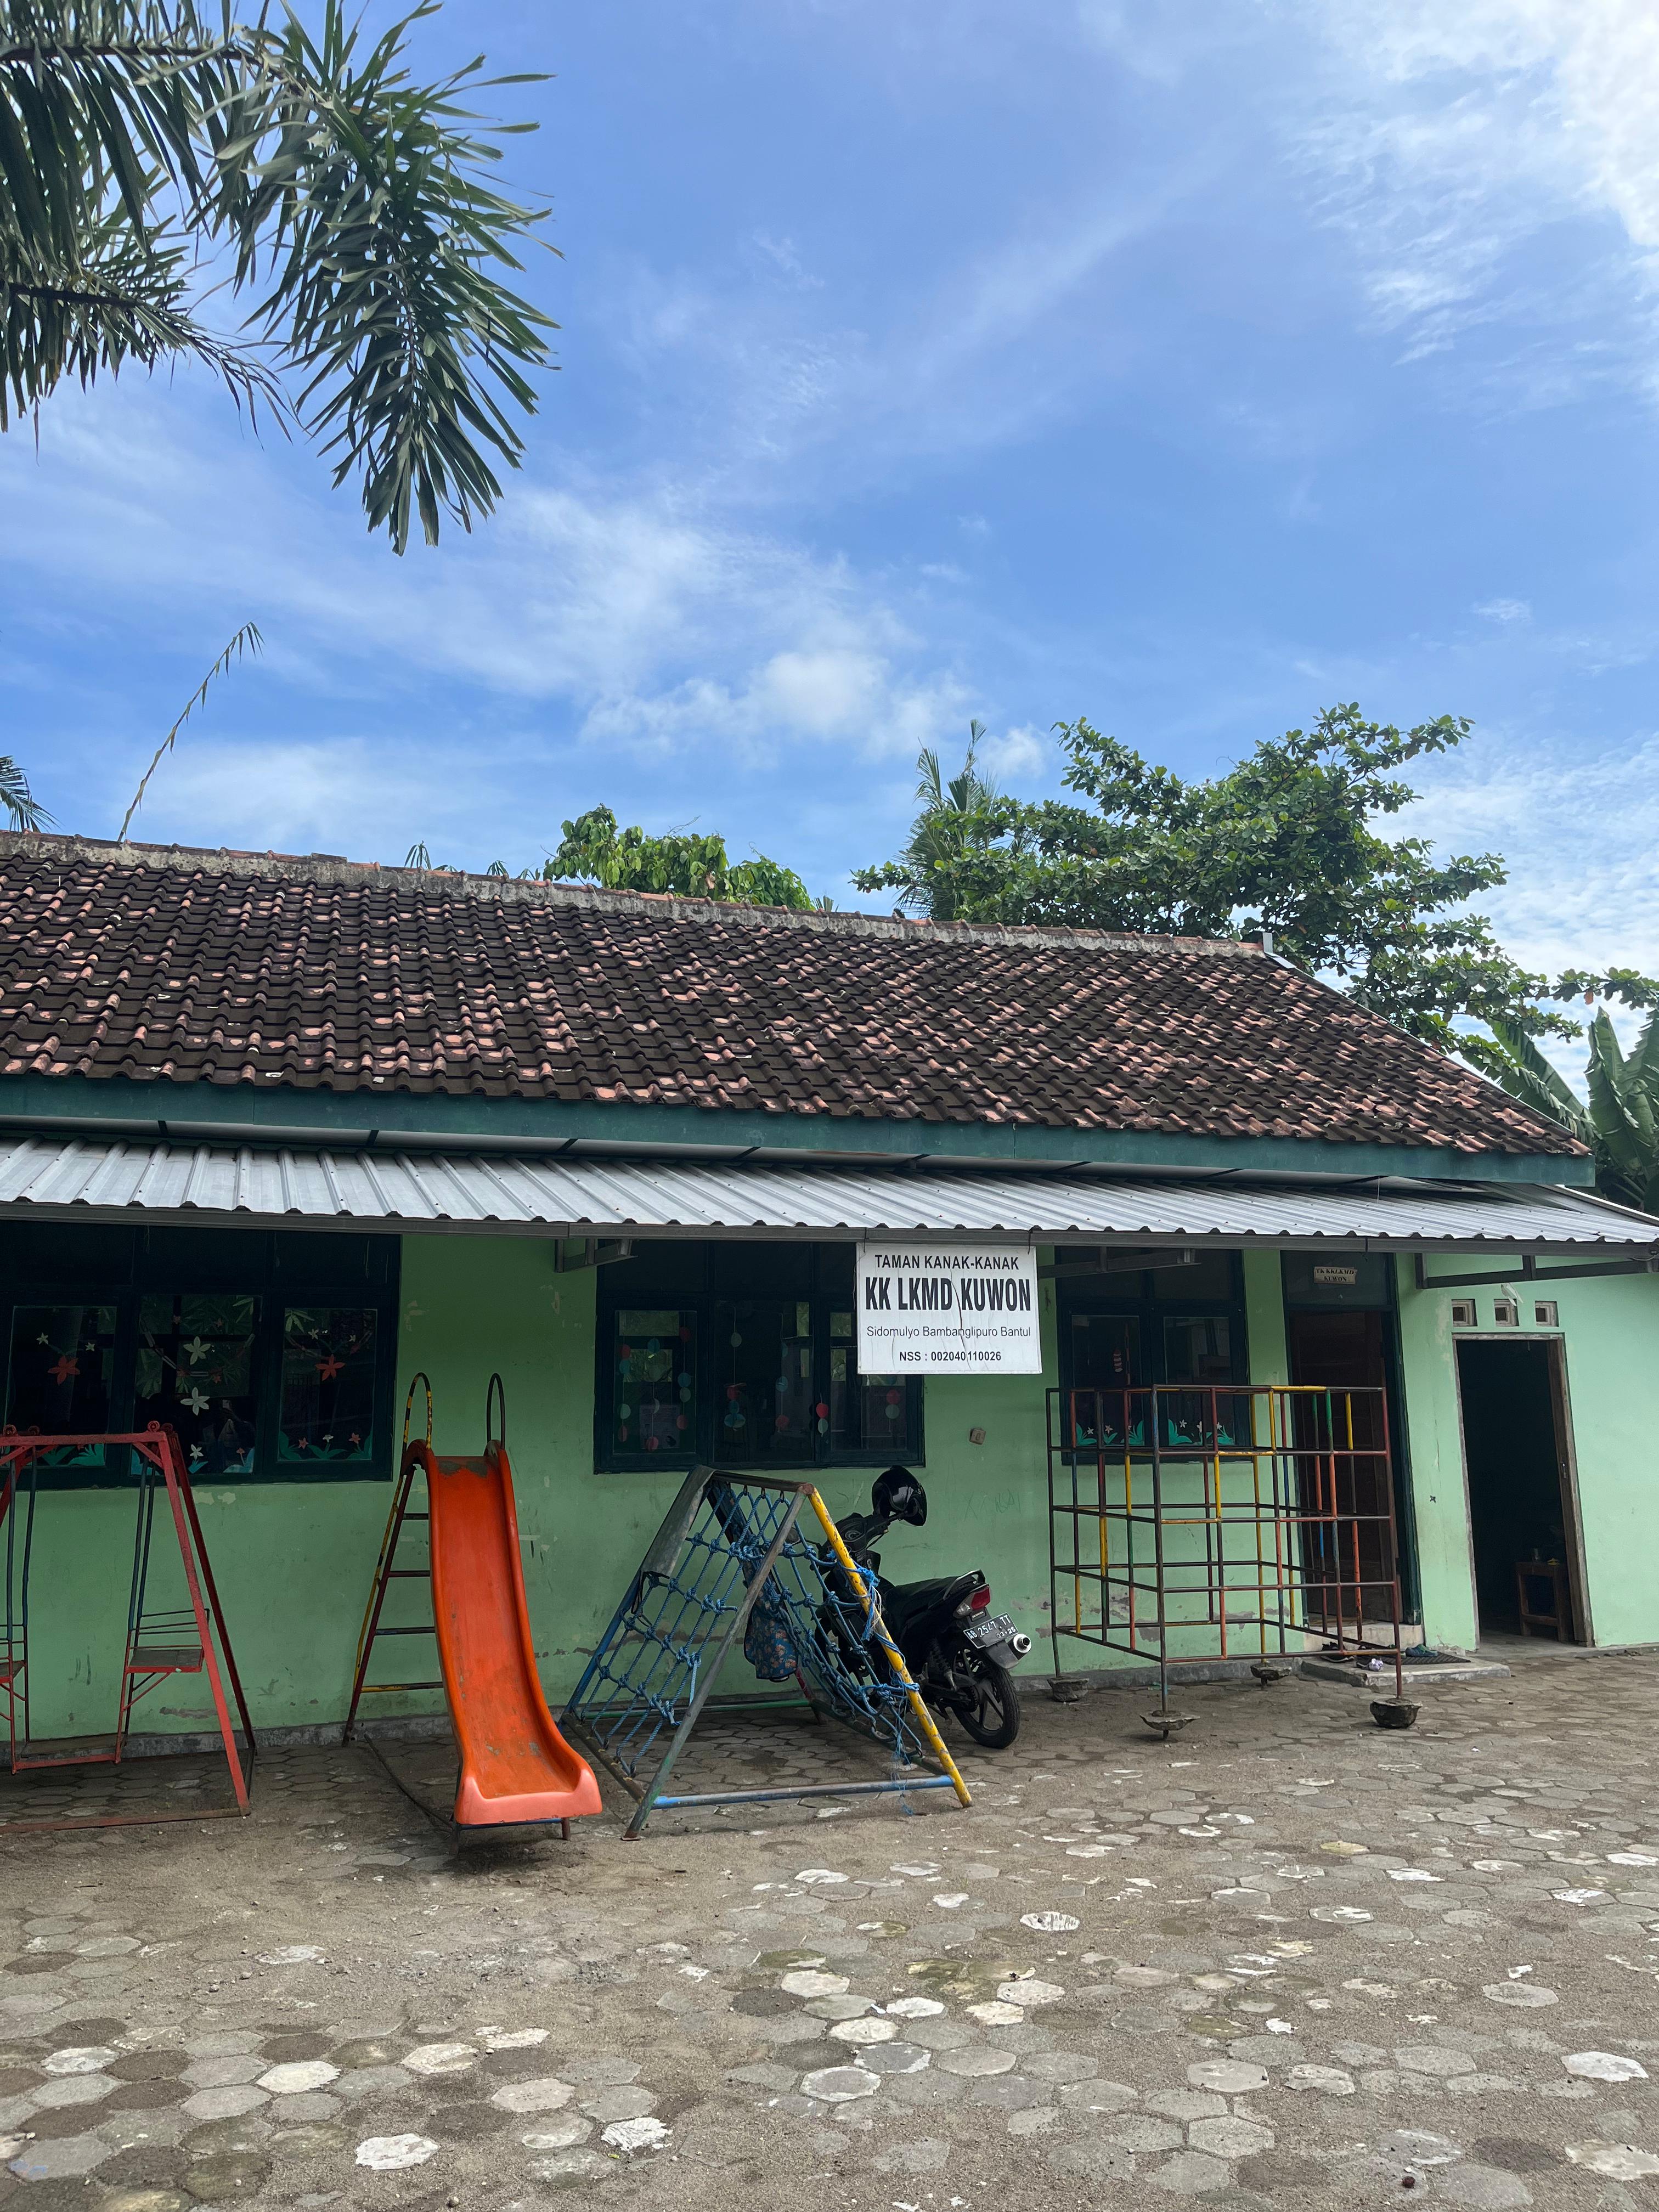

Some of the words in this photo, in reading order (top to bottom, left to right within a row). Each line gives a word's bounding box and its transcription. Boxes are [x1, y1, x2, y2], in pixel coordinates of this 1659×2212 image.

[874, 1255, 920, 1269] TAMAN
[924, 1255, 1019, 1270] KANAK-KANAK
[865, 1277, 891, 1311] KK
[898, 1277, 953, 1311] LKMD
[961, 1278, 1031, 1311] KUWON
[866, 1326, 920, 1339] Sidomulyo
[923, 1326, 998, 1339] Bambanglipuro
[1001, 1327, 1031, 1337] Bantul
[899, 1351, 922, 1361] NSS
[930, 1351, 1002, 1361] 002040110026
[967, 1630, 978, 1639] AB
[999, 1615, 1011, 1626] TT
